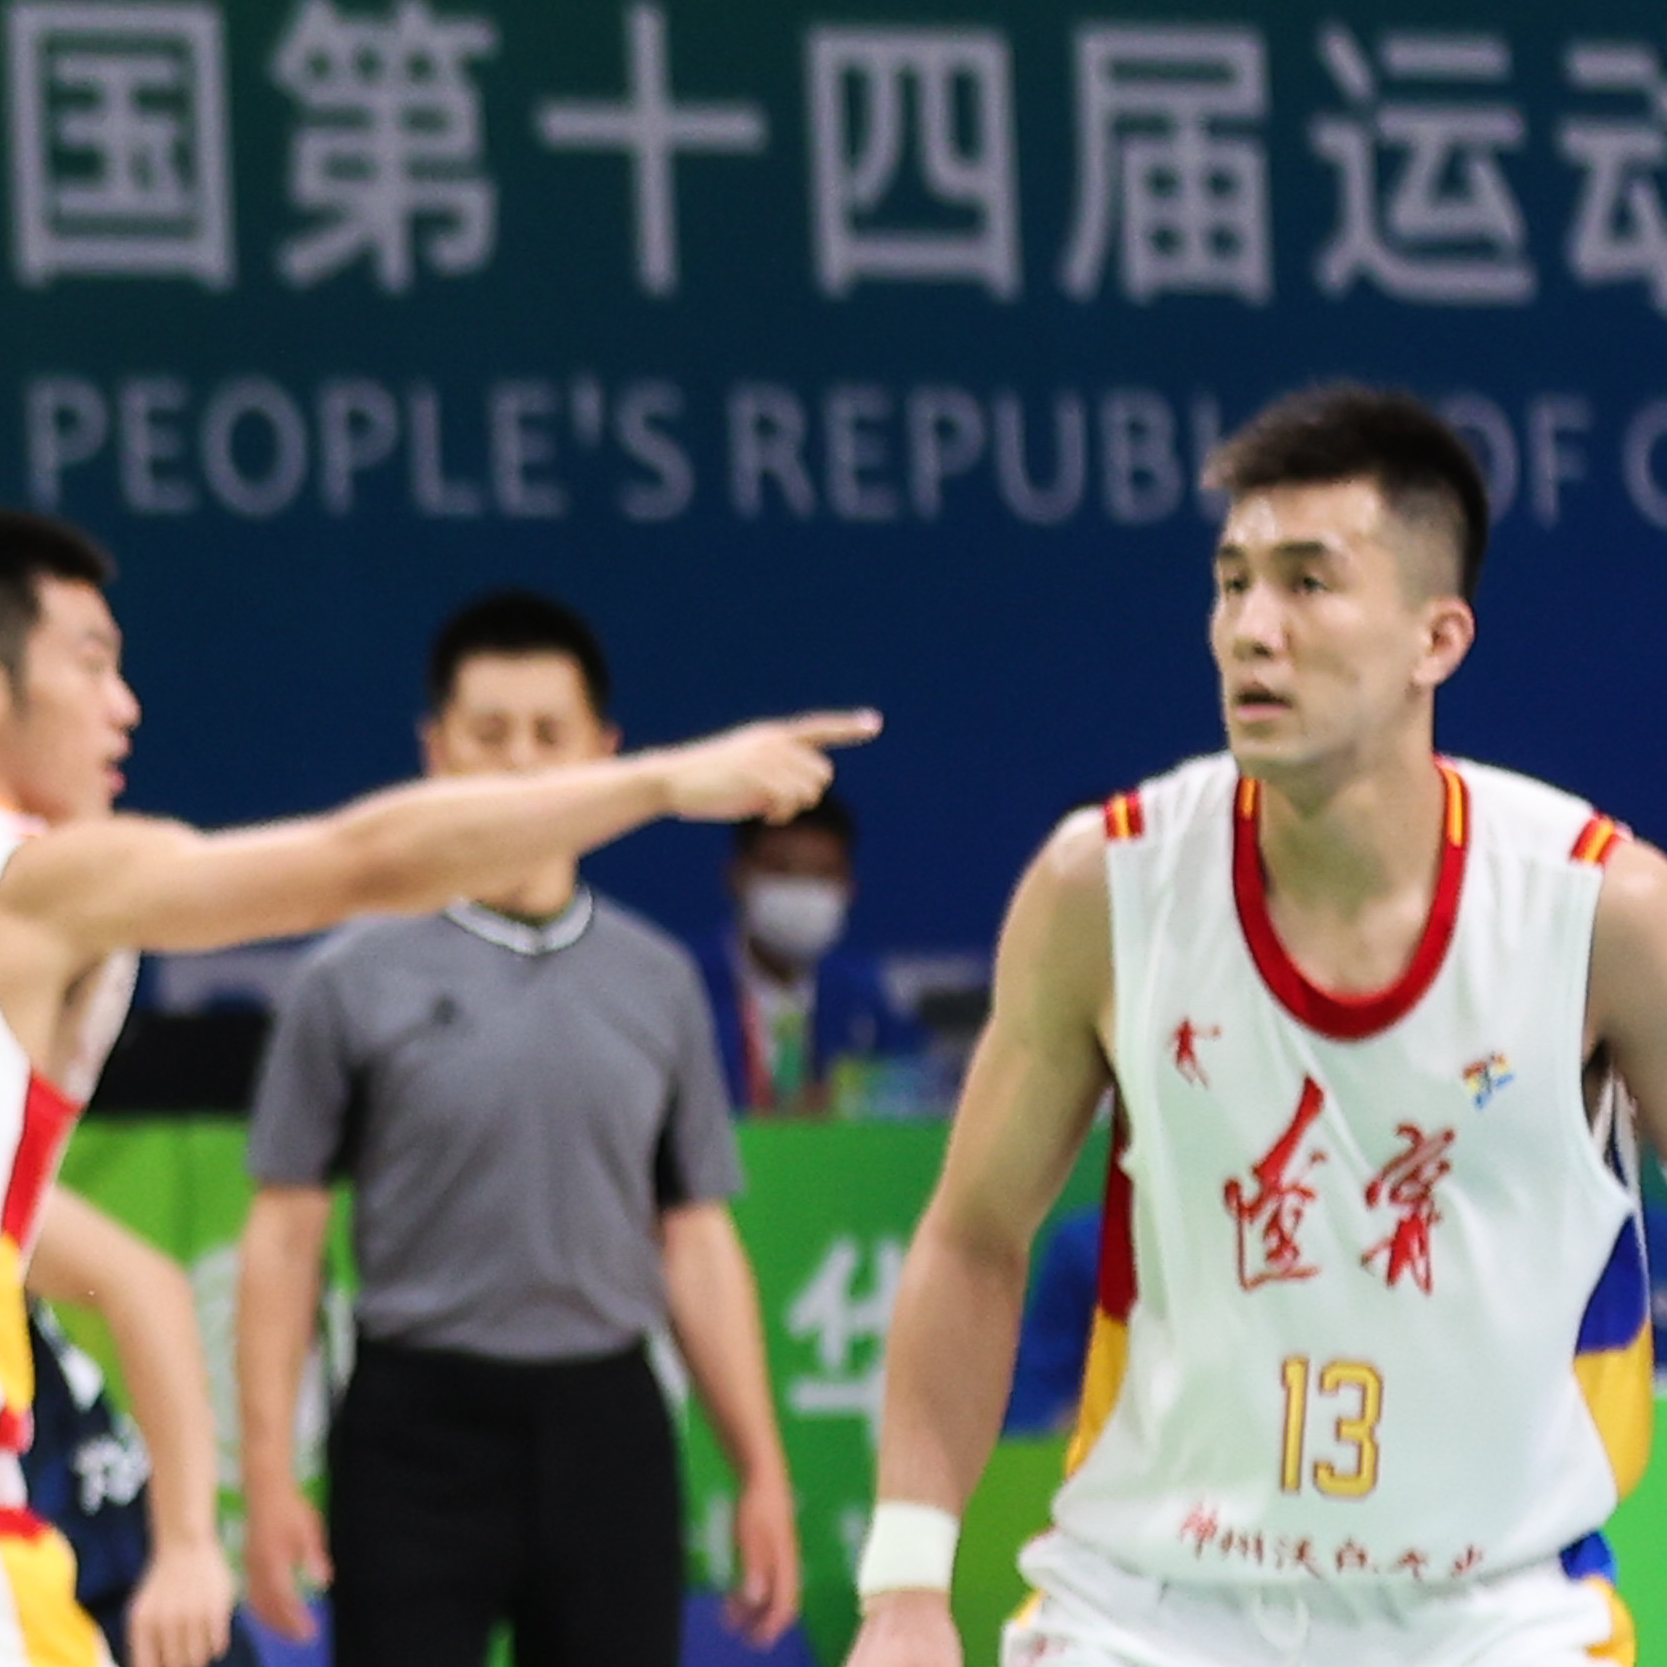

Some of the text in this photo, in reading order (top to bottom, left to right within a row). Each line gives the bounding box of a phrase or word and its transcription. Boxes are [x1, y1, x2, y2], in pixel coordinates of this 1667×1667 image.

[28, 373, 696, 524] PEOPLE'S
[727, 381, 1229, 527] REPUBL
[1280, 1355, 1383, 1501] 13
